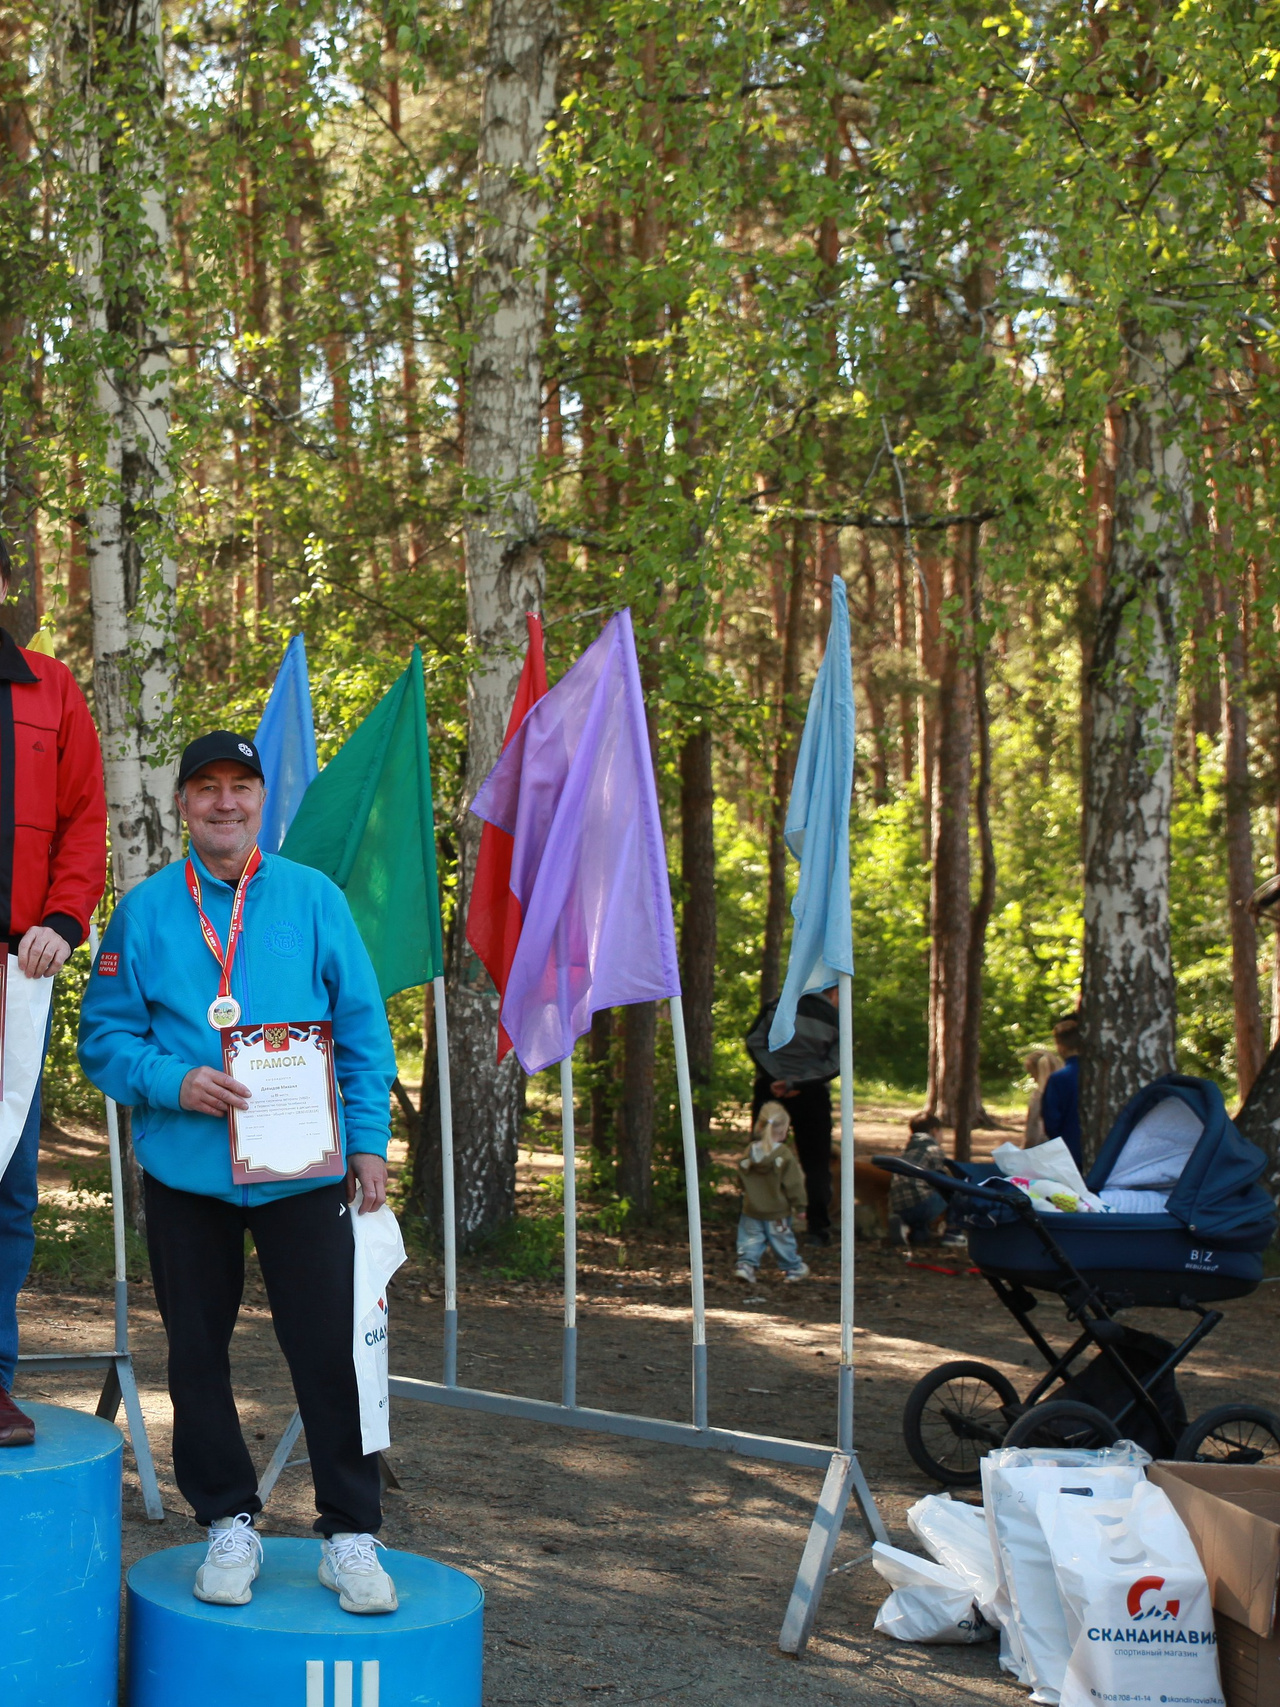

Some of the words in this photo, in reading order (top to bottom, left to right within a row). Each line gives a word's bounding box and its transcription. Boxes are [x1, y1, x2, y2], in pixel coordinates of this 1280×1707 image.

[206, 928, 213, 936] 15
[208, 934, 218, 948] лет
[250, 1056, 306, 1070] ГРАМОТА
[1114, 1648, 1162, 1657] спортивный
[1164, 1650, 1198, 1658] магазин
